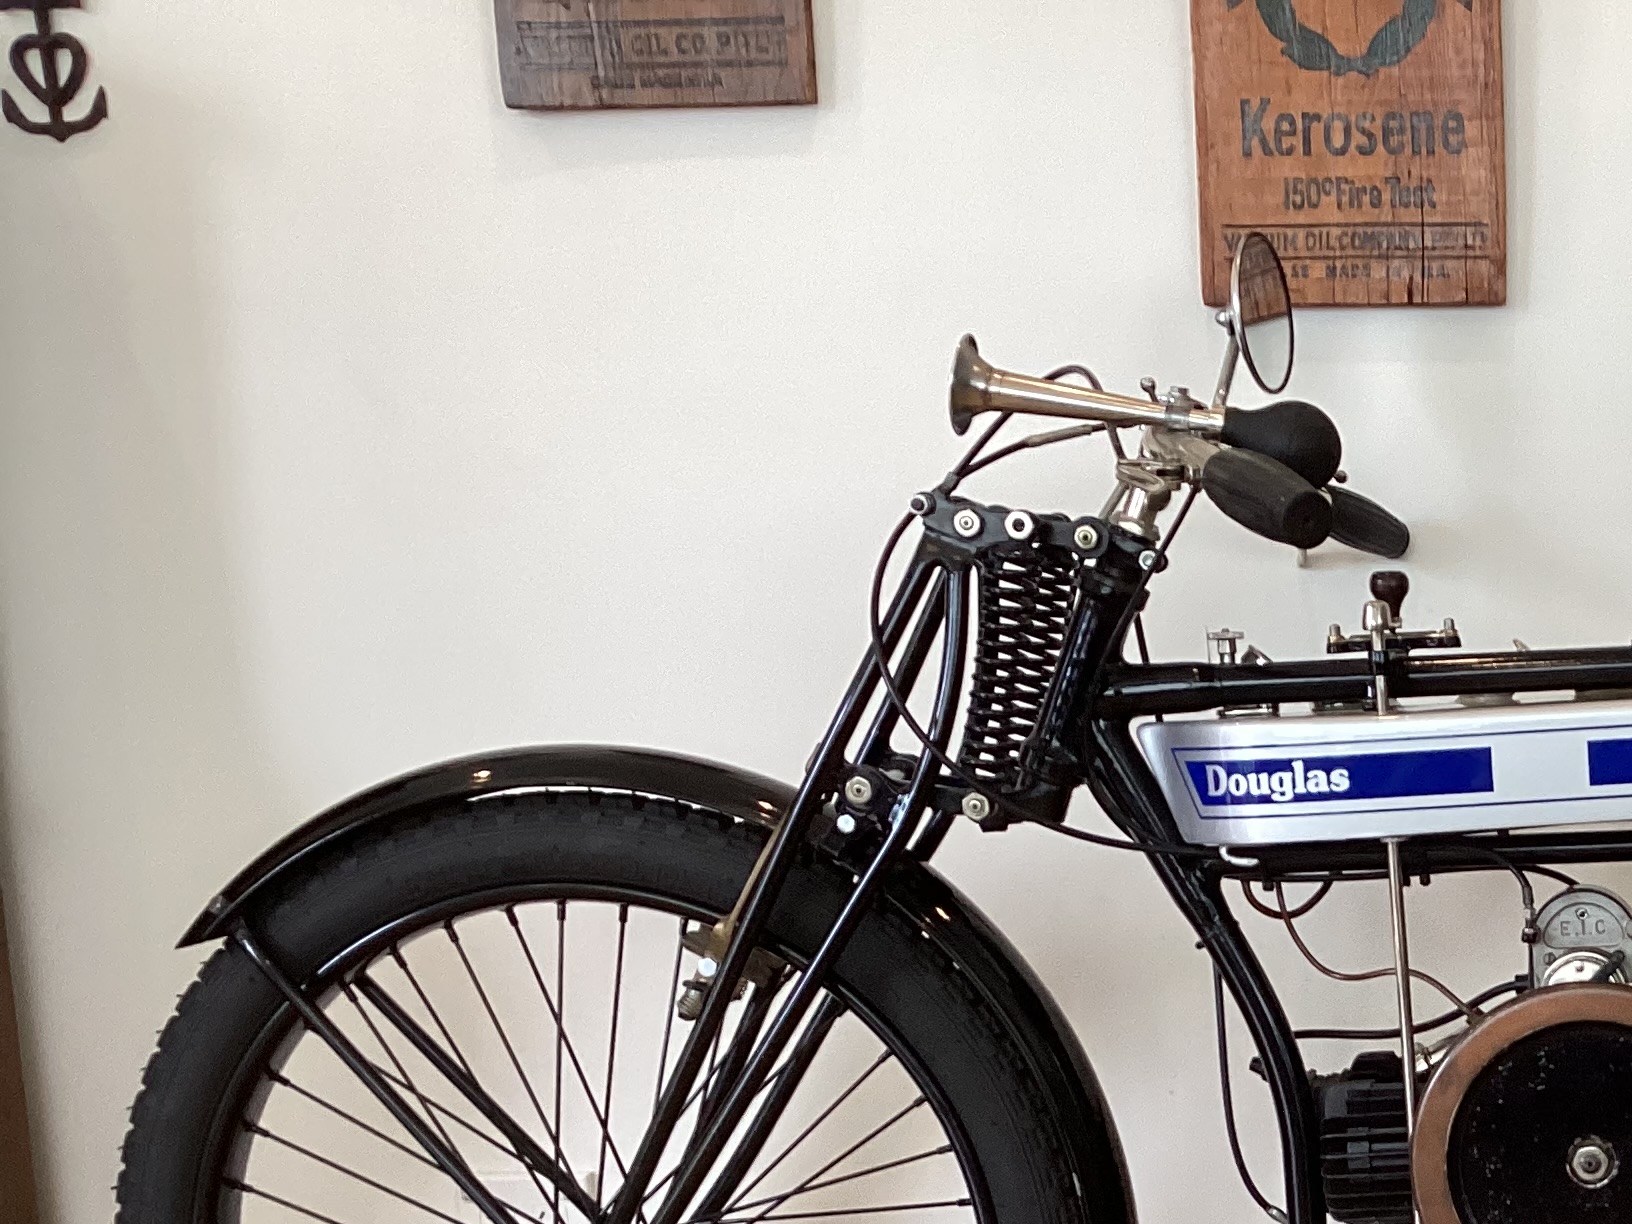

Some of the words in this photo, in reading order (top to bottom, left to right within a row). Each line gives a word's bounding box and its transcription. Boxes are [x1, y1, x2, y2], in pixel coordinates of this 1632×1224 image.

[1240, 97, 1467, 158] Kerosene
[1305, 229, 1335, 251] OIL
[1205, 759, 1350, 802] Douglas
